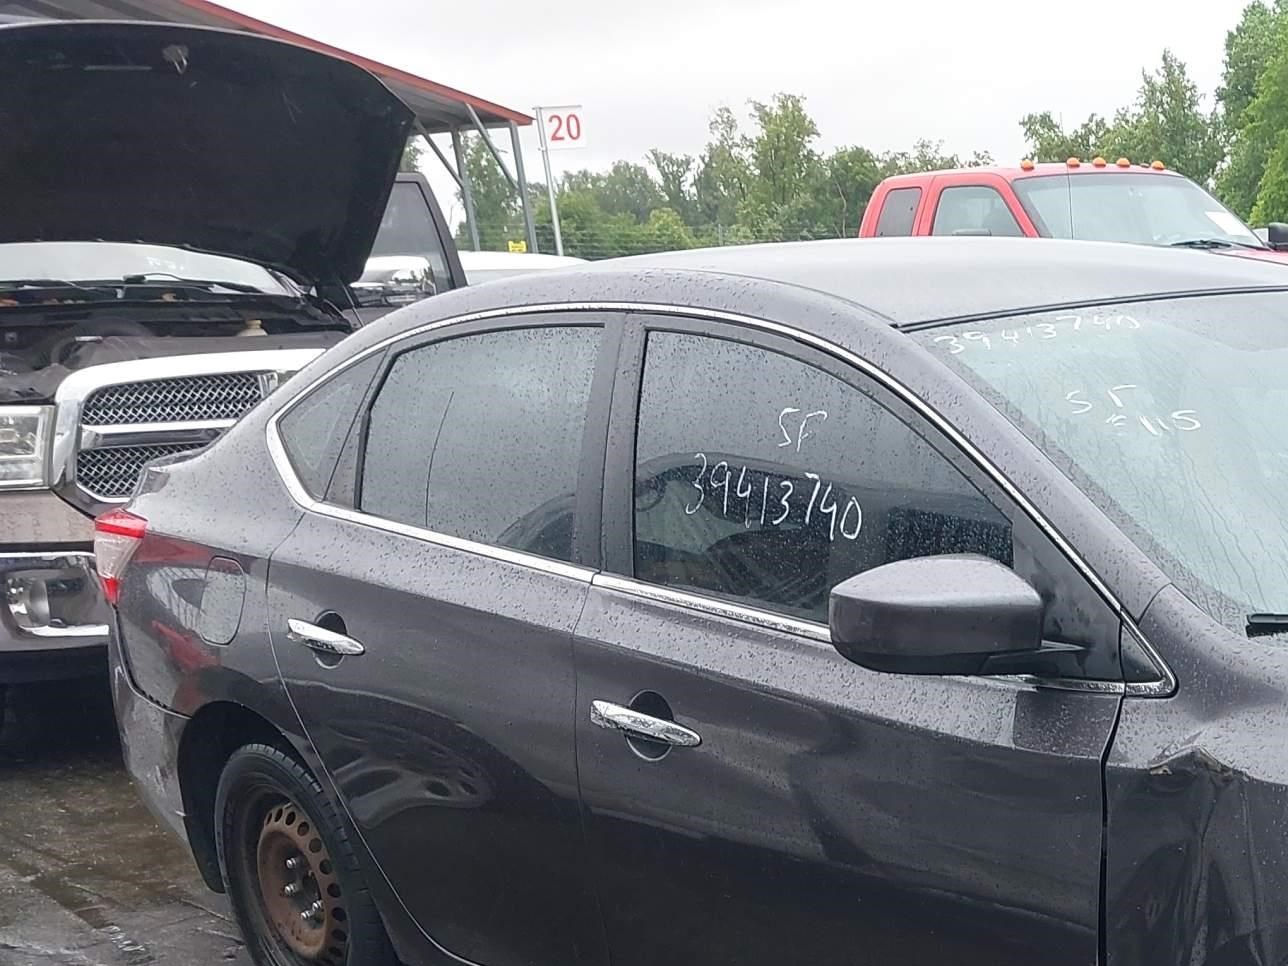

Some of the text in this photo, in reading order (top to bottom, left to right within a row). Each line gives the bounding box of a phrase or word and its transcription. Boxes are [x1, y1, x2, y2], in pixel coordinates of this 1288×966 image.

[549, 114, 581, 141] 20
[934, 315, 1141, 354] 39413740
[778, 407, 828, 452] SF
[685, 452, 863, 542] 39413740
